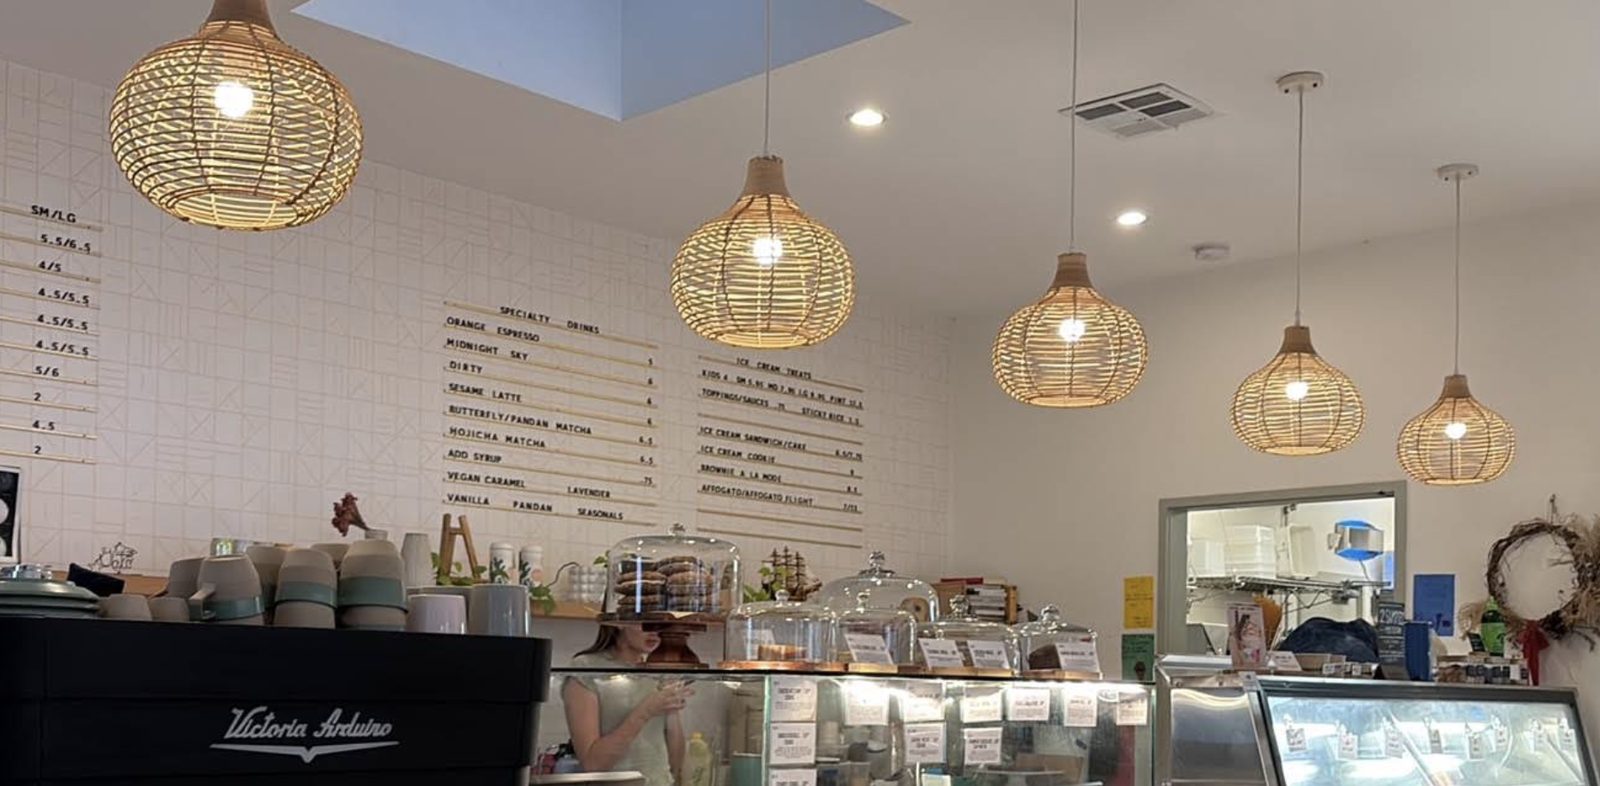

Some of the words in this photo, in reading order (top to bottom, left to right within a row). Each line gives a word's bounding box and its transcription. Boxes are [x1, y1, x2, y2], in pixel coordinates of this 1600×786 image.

[31, 205, 76, 223] SM/LG
[41, 234, 91, 253] 5.5/6.5
[39, 261, 62, 272] 4/5
[38, 288, 90, 305] 4.5/5.5
[37, 315, 88, 331] 4.5/5.5
[447, 316, 486, 332] ORANGE
[497, 327, 540, 343] ESPRESSO
[499, 306, 551, 324] SPECIALTY
[567, 320, 600, 335] DRINKS
[36, 340, 88, 356] 4.5/5.5
[447, 338, 498, 355] MIDNIGHT
[511, 350, 529, 362] SKY
[35, 366, 59, 377] 5/6
[450, 360, 482, 374] DIRTY
[736, 357, 749, 368] ICE
[757, 361, 780, 373] CREAM
[787, 367, 811, 380] TREATS
[34, 392, 41, 401] 2
[449, 383, 484, 396] SESAME
[492, 390, 522, 403] LATTE
[702, 369, 720, 380] KIDS
[830, 395, 846, 406] PINT
[702, 388, 769, 408] TOPPINGS/SAUCES
[802, 406, 828, 420] STICKY
[829, 412, 844, 423] RICE
[33, 420, 55, 430] 4.5
[449, 405, 549, 428] BUTTERFLY/PANDAN
[556, 421, 593, 435] MATCHA
[449, 427, 498, 442] HOJICHA
[505, 434, 546, 449] MATCHA
[700, 426, 712, 436] ICE
[716, 429, 741, 439] CREAM
[744, 433, 806, 451] SANDWICH/CAKE
[34, 446, 41, 454] 2
[448, 449, 468, 460] ADD
[473, 452, 502, 464] SYRUP
[701, 445, 713, 455] ICE
[717, 448, 742, 458] CREAM
[747, 452, 775, 463] COOKIE
[701, 464, 734, 476] BROWNIE
[750, 472, 759, 480] LA
[762, 473, 781, 484] MODE
[447, 471, 480, 485] VEGAN
[485, 475, 525, 489] CARAMEL
[567, 485, 610, 499] LAVENDER
[702, 484, 783, 502] AFFOGATO/AFFOGATO
[786, 494, 813, 507] FLIGHT
[447, 493, 490, 507] VANILLA
[513, 500, 552, 513] PANDAN
[577, 507, 623, 521] SEASONALS
[224, 706, 307, 739] Victoria
[313, 708, 393, 738] Arduino
